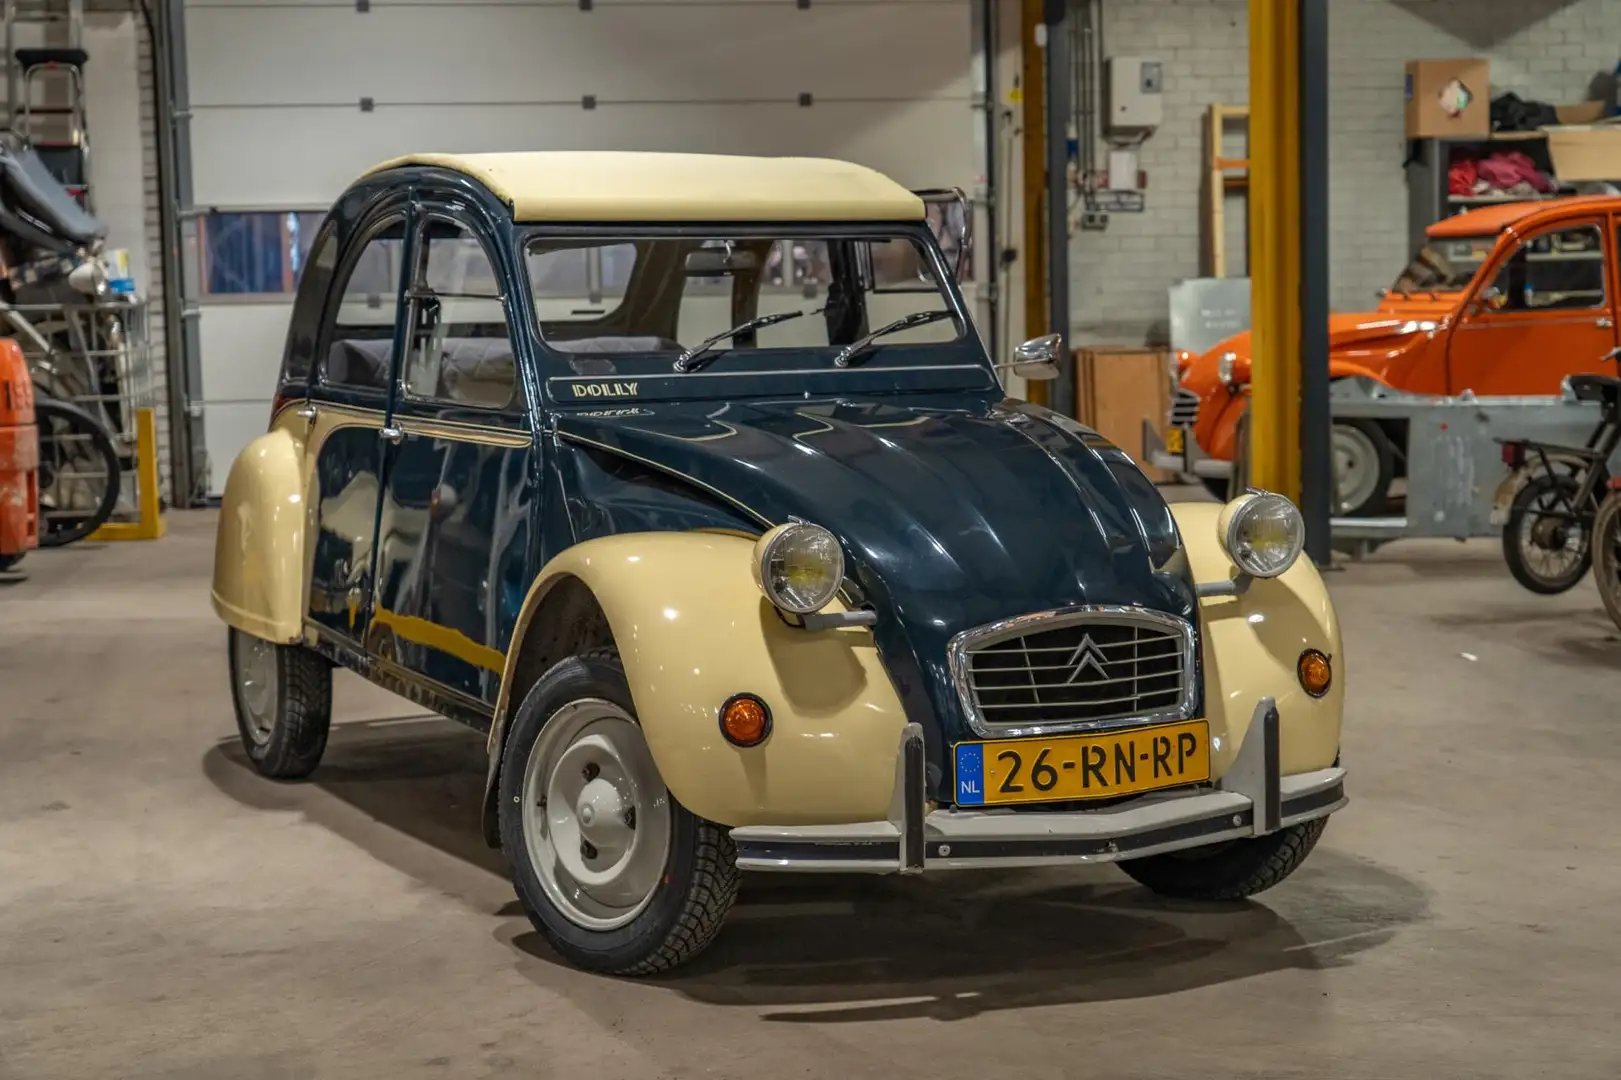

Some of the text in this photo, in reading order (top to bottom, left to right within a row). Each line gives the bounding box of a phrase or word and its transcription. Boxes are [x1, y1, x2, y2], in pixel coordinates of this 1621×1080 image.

[572, 382, 638, 397] DOLLY
[997, 732, 1197, 793] 26-RN-RP
[961, 780, 980, 794] NL
